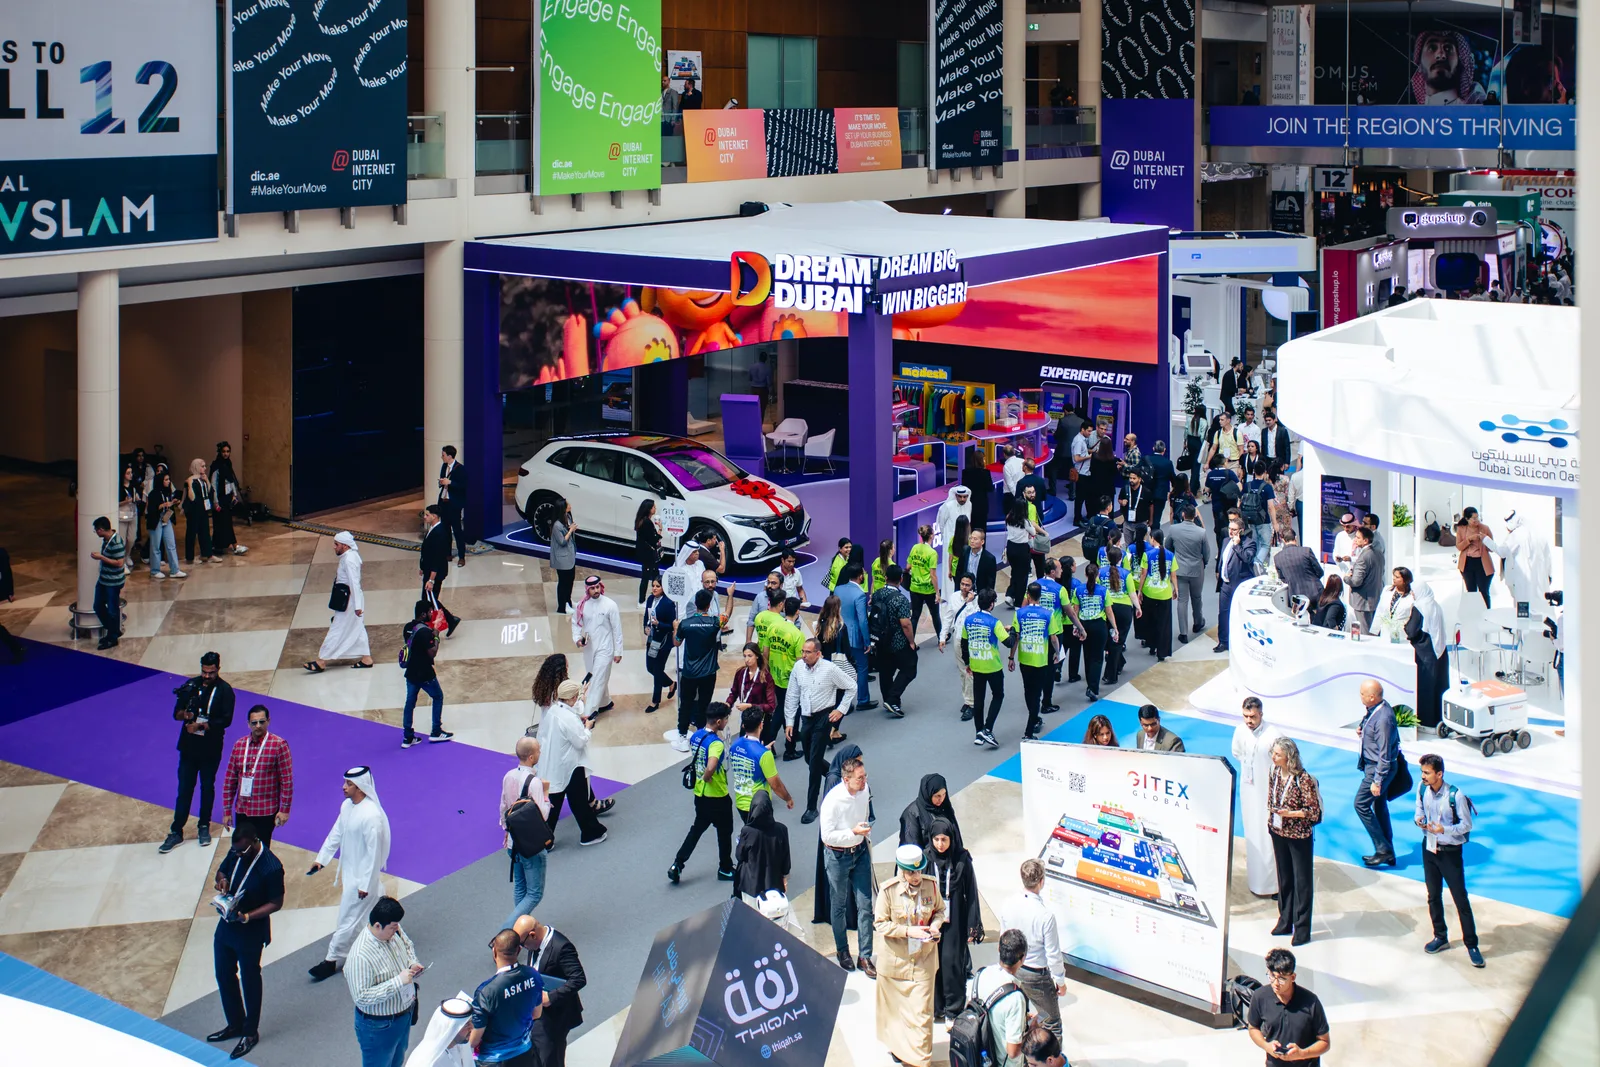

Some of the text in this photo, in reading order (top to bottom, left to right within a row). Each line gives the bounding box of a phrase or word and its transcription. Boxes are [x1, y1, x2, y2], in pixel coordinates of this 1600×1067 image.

[318, 8, 370, 36] Make Your
[938, 14, 954, 36] Make
[1272, 8, 1295, 24] GITEX
[616, 4, 662, 73] Engag
[940, 30, 960, 52] Make
[958, 14, 977, 34] Your
[1272, 28, 1294, 36] AFRICA
[232, 13, 297, 73] ake Your Move
[353, 25, 390, 75] Make Your
[940, 48, 966, 70] Make
[964, 32, 986, 50] Your
[985, 20, 1004, 38] Mov
[32, 41, 65, 64] TO
[358, 60, 408, 88] Make Your
[938, 50, 996, 88] Make Your
[1283, 74, 1293, 82] MEET
[260, 52, 333, 114] Make Your Move
[1342, 82, 1378, 92] NEM
[0, 60, 180, 134] LL 12
[266, 67, 338, 126] Make Your Move
[936, 82, 974, 107] Make
[717, 128, 737, 138] DUBAI
[980, 130, 993, 138] DUBAI
[1266, 116, 1564, 137] JOIN THE REGION'S THRIVING
[622, 142, 642, 152] DUBAI
[718, 139, 748, 150] INTERNET
[980, 138, 998, 148] INTERNET
[980, 148, 990, 156] CITY
[352, 149, 380, 162] DUBAI
[552, 159, 573, 168] dic.ae
[622, 153, 654, 164] INTERNET
[719, 153, 734, 164] CITY
[1133, 150, 1165, 162] DUBAI
[250, 170, 280, 182] dic.ae
[352, 163, 396, 176] INTERNET
[552, 170, 605, 181] #MakeYourMove
[622, 166, 638, 177] CITY
[1133, 164, 1185, 177] INTERNET
[1322, 170, 1346, 187] 12
[250, 182, 328, 196] #MakeYourMove
[352, 178, 374, 191] CITY
[1133, 178, 1157, 190] CITY
[0, 194, 155, 242] VSLAM
[1420, 212, 1466, 226] gupshup
[774, 253, 872, 285] DREAM
[880, 248, 960, 280] DREAM BIG,
[774, 281, 864, 314] DUBAI
[882, 281, 969, 316] WIN BIGGER!
[1040, 365, 1134, 386] EXPERIENCE IT!
[1478, 460, 1580, 483] Dubai Silicon Oas
[662, 508, 684, 516] GITEX
[968, 640, 992, 650] ZERO
[1021, 635, 1044, 644] ZERO
[1126, 770, 1190, 800] GITEX
[1132, 790, 1190, 810] GLOBAL
[1095, 867, 1146, 887] DIGITAL CITIES
[504, 977, 536, 999] ASK ME
[735, 1004, 808, 1044] THIQAH
[772, 1032, 804, 1053] thiqah.sa
